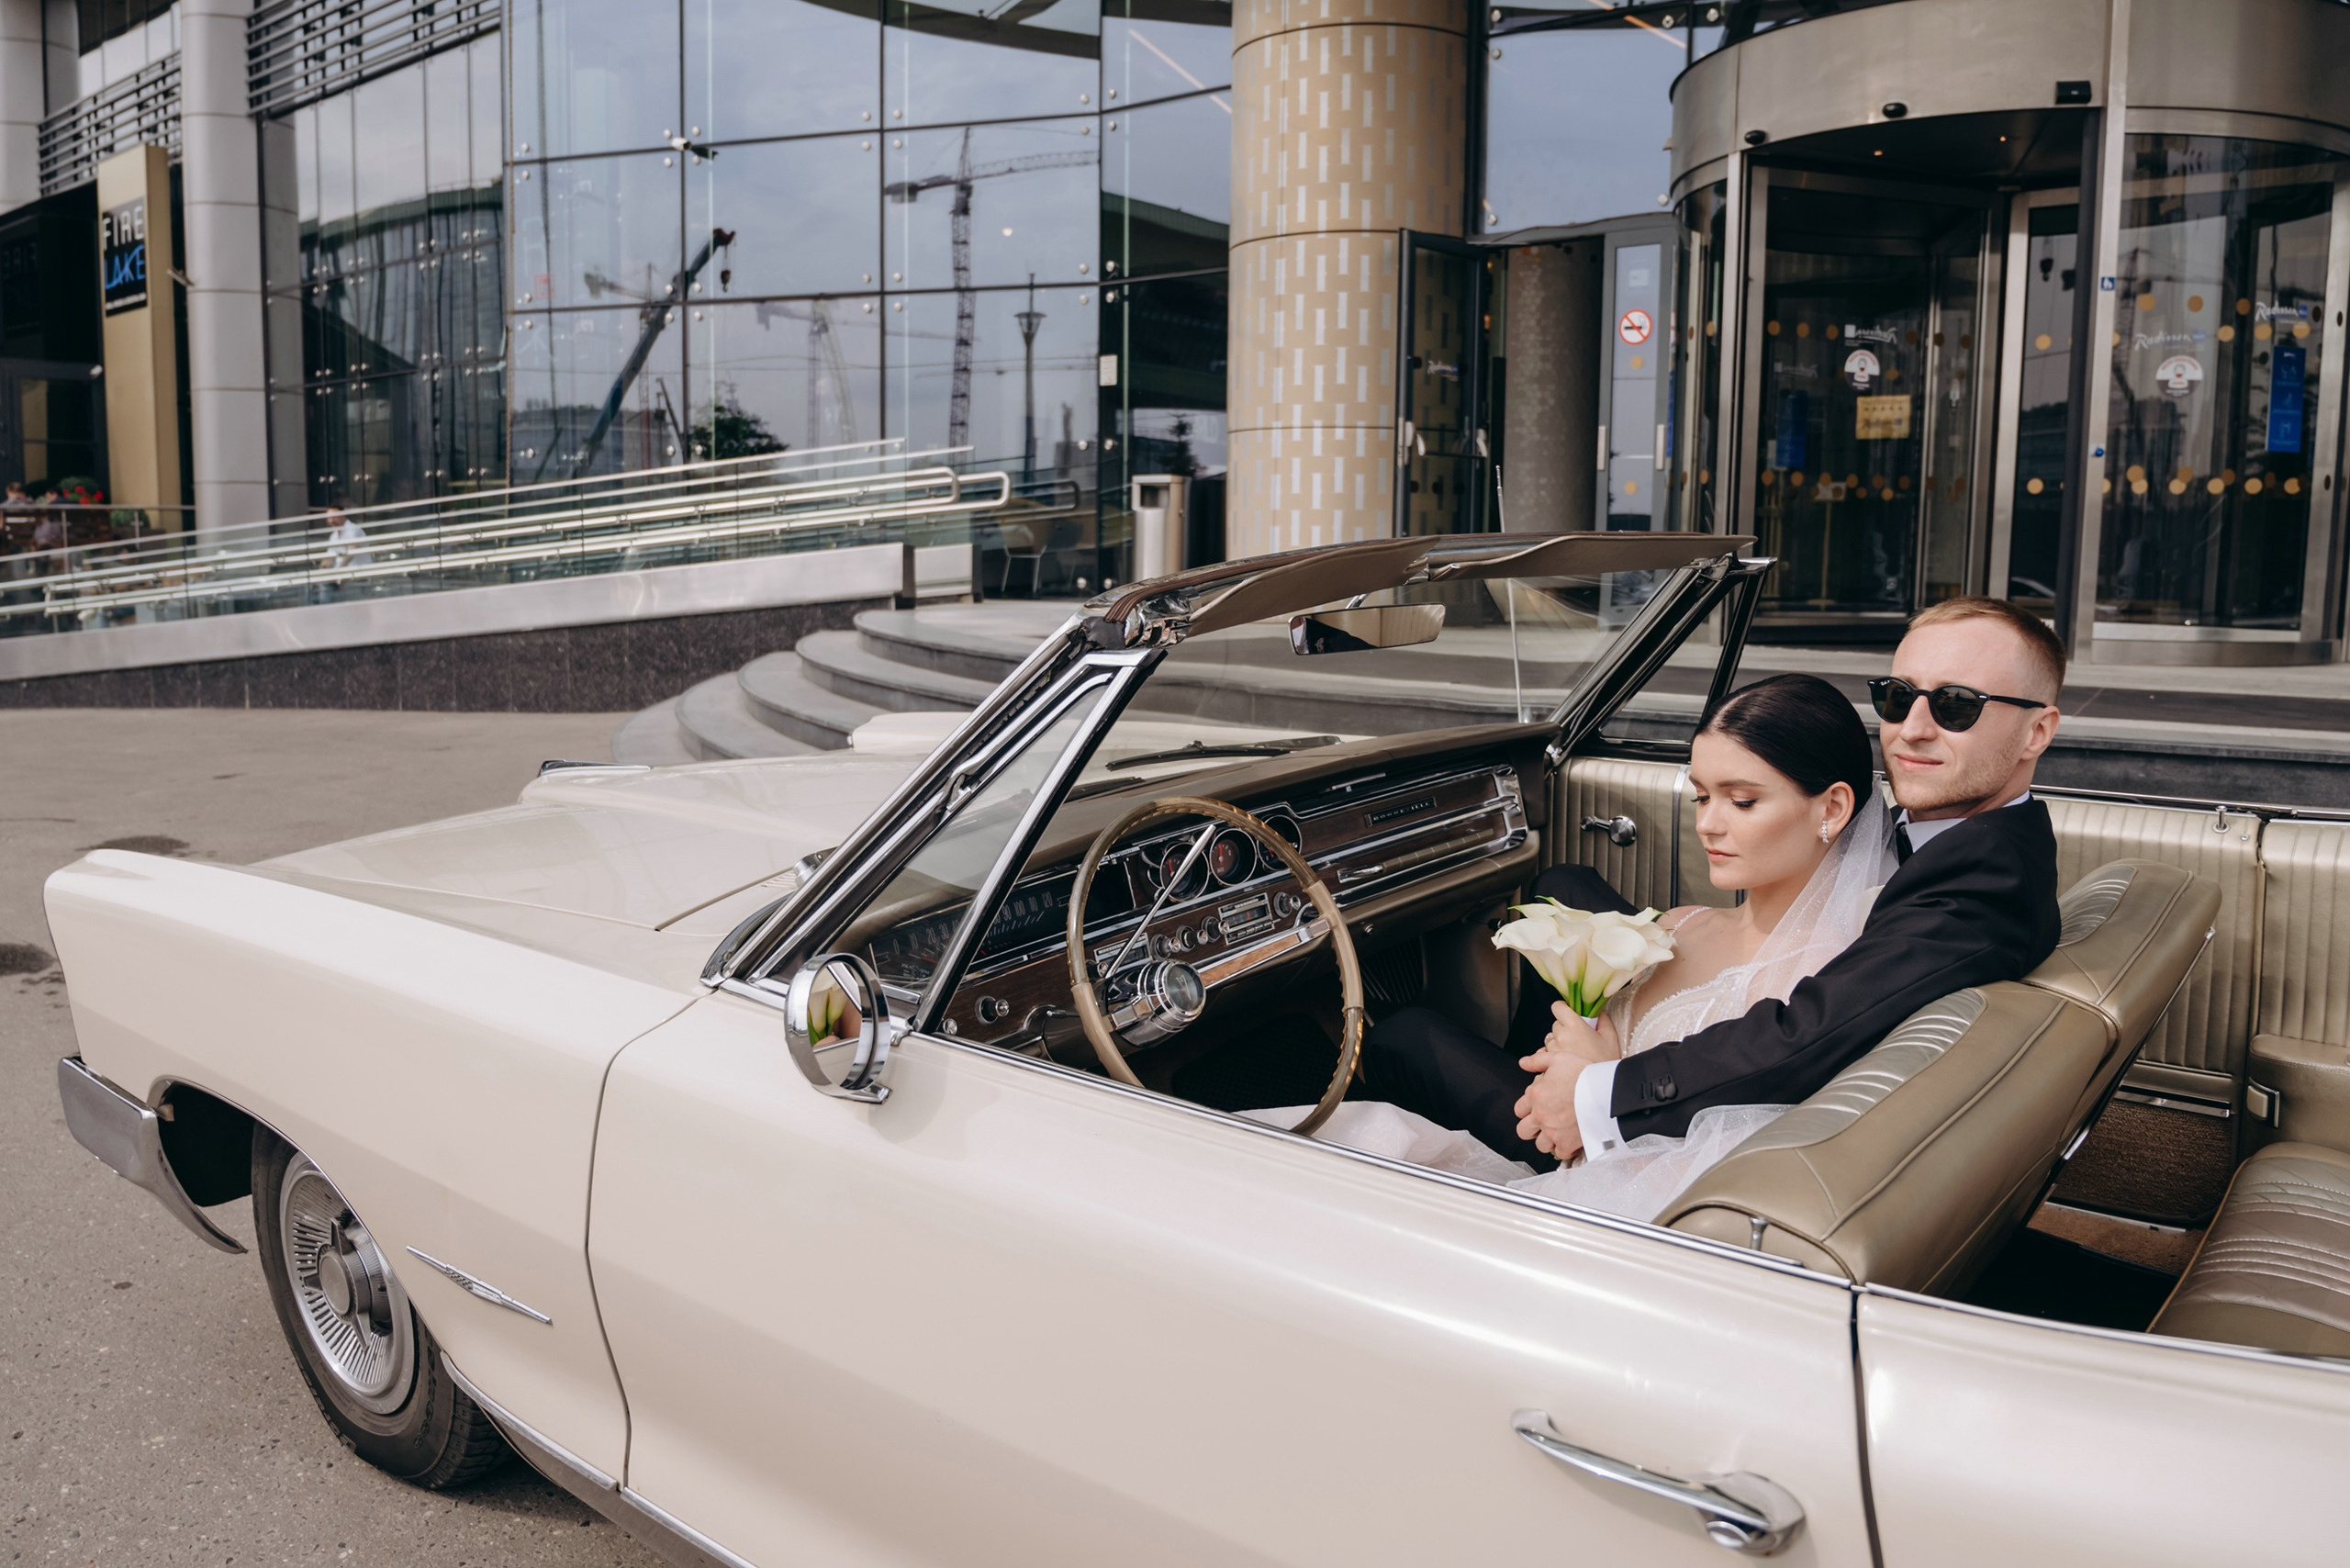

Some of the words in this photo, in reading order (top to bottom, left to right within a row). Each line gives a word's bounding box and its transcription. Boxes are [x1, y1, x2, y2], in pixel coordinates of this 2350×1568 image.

[103, 205, 145, 251] FIRE
[105, 244, 146, 289] LAKE
[892, 938, 901, 956] 0
[925, 926, 936, 945] 20
[938, 923, 949, 940] 30
[1002, 904, 1012, 921] 90
[1041, 891, 1053, 908] 120
